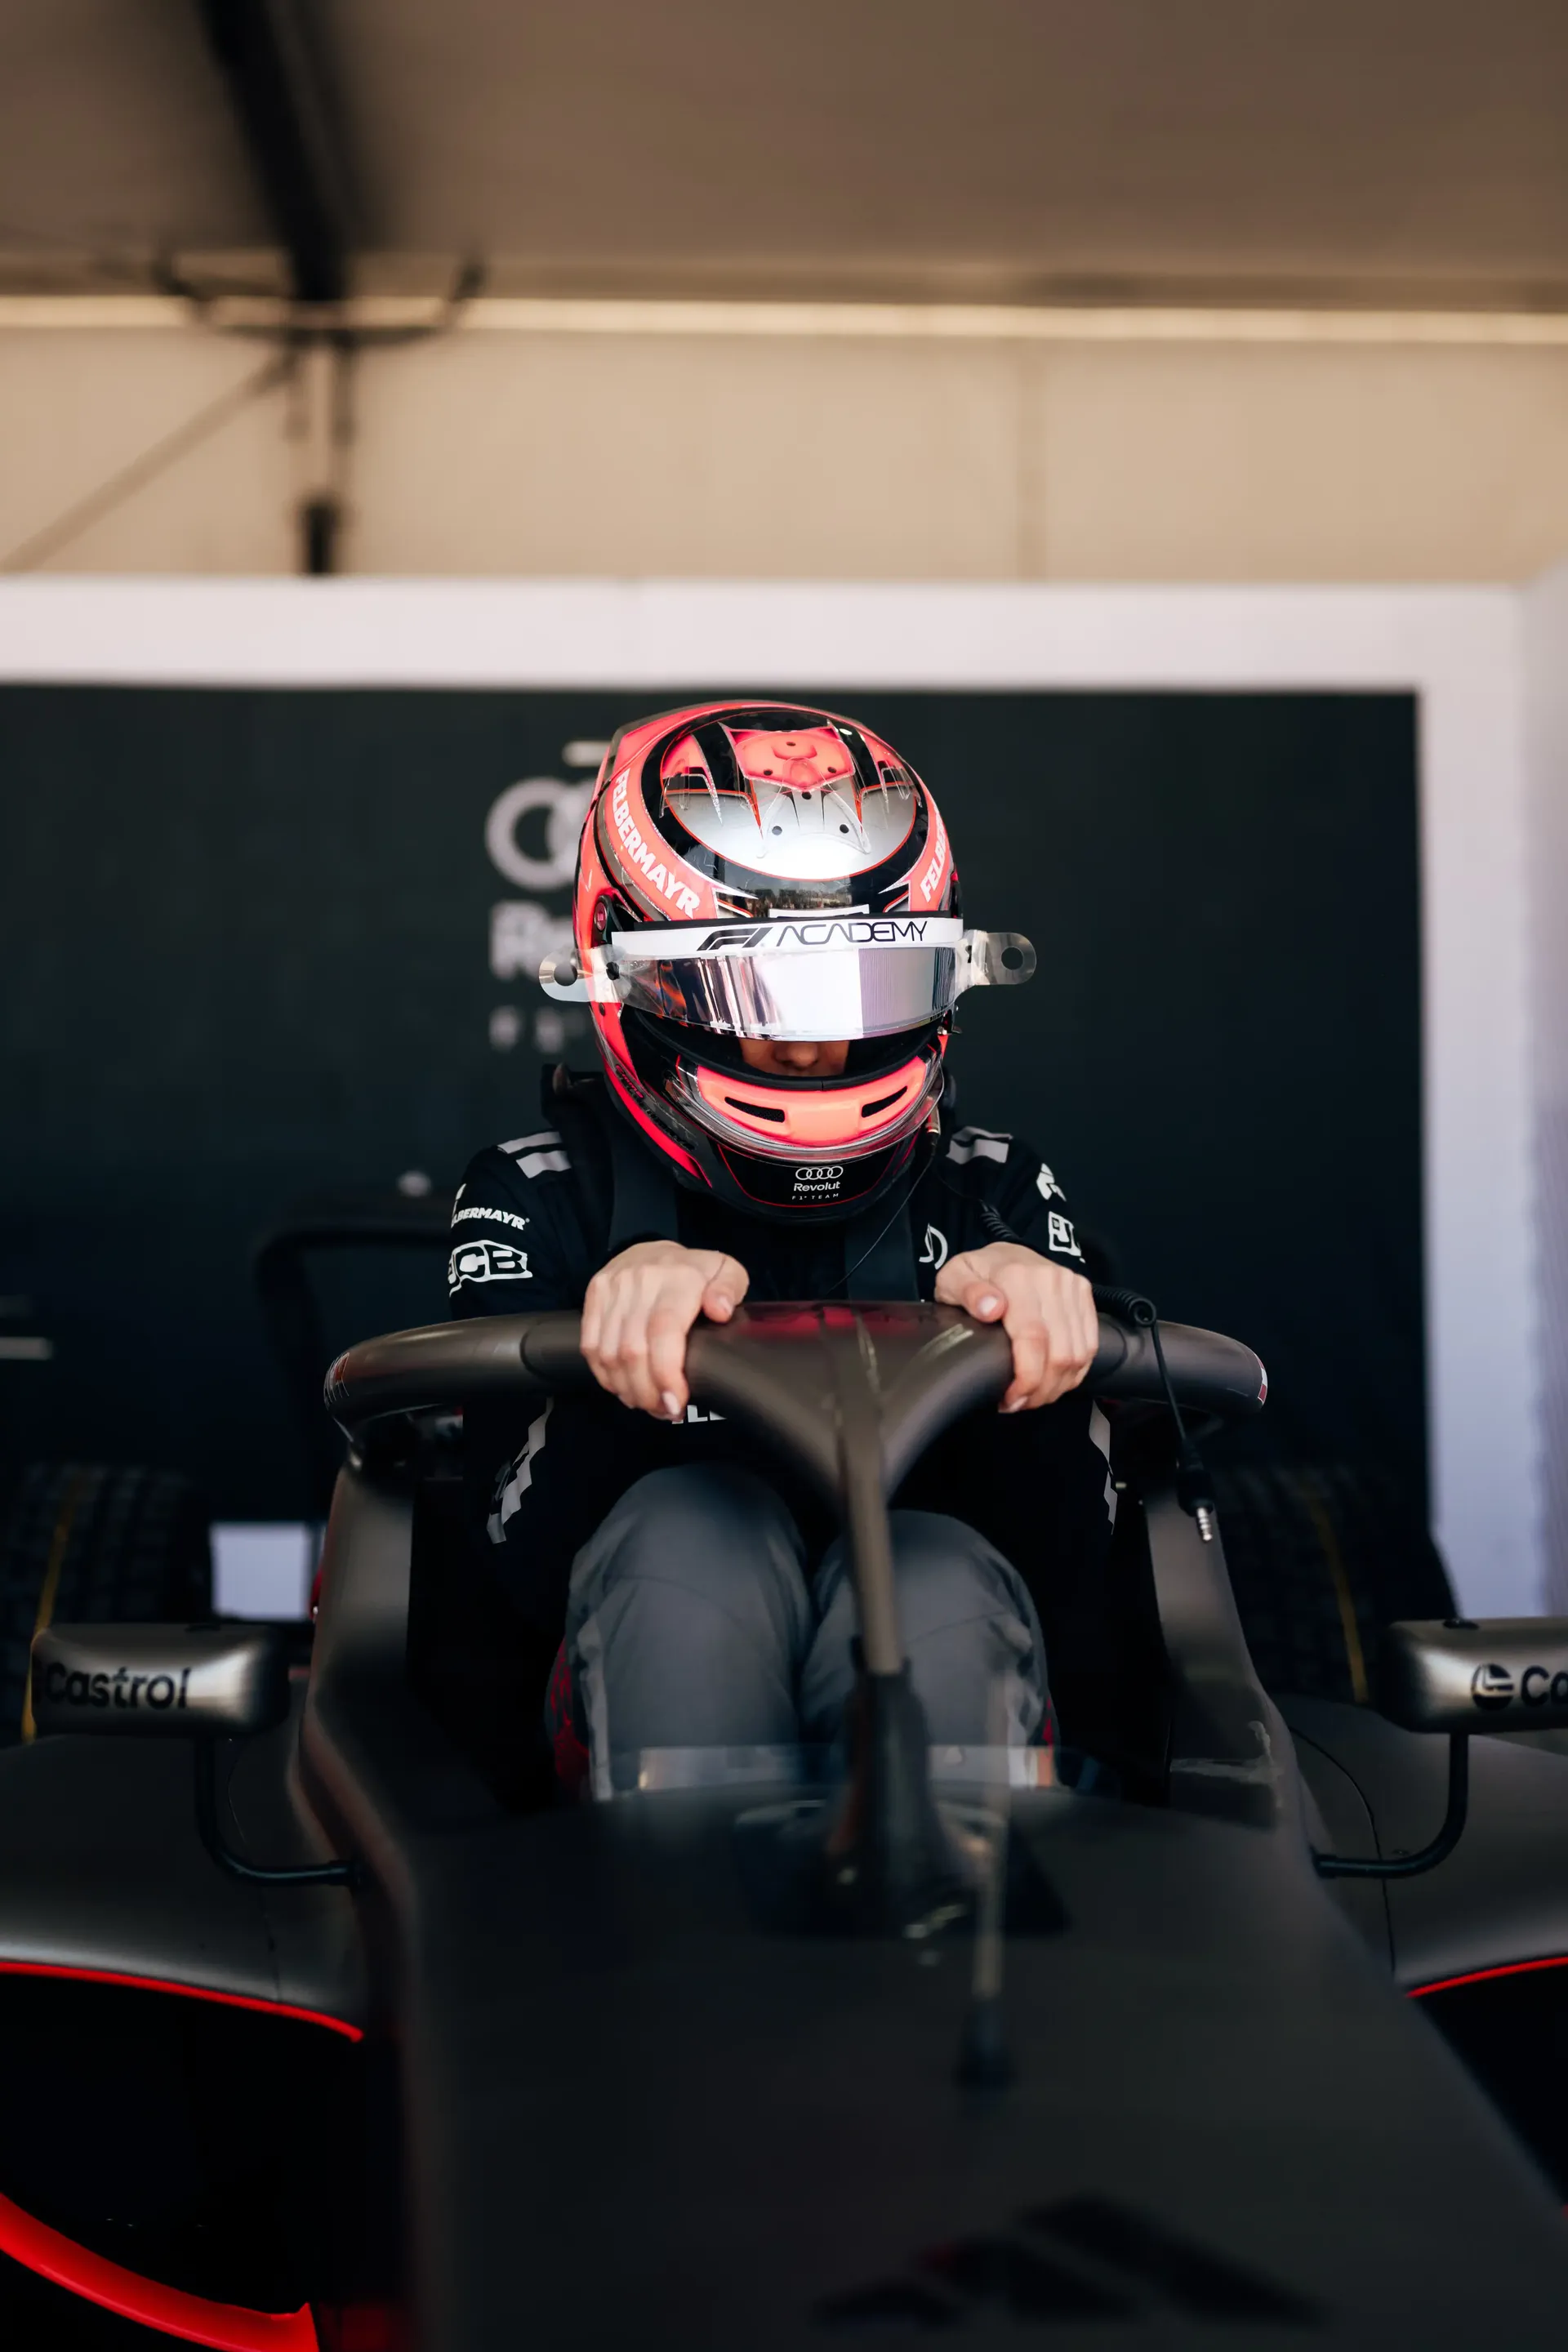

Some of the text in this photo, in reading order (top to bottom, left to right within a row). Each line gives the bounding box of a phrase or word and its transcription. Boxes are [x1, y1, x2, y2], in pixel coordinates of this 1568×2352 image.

[612, 768, 700, 919] FELBERMAYR
[777, 920, 928, 947] ACADEMY
[793, 1181, 840, 1192] Revolut
[45, 1662, 191, 1709] Castrol
